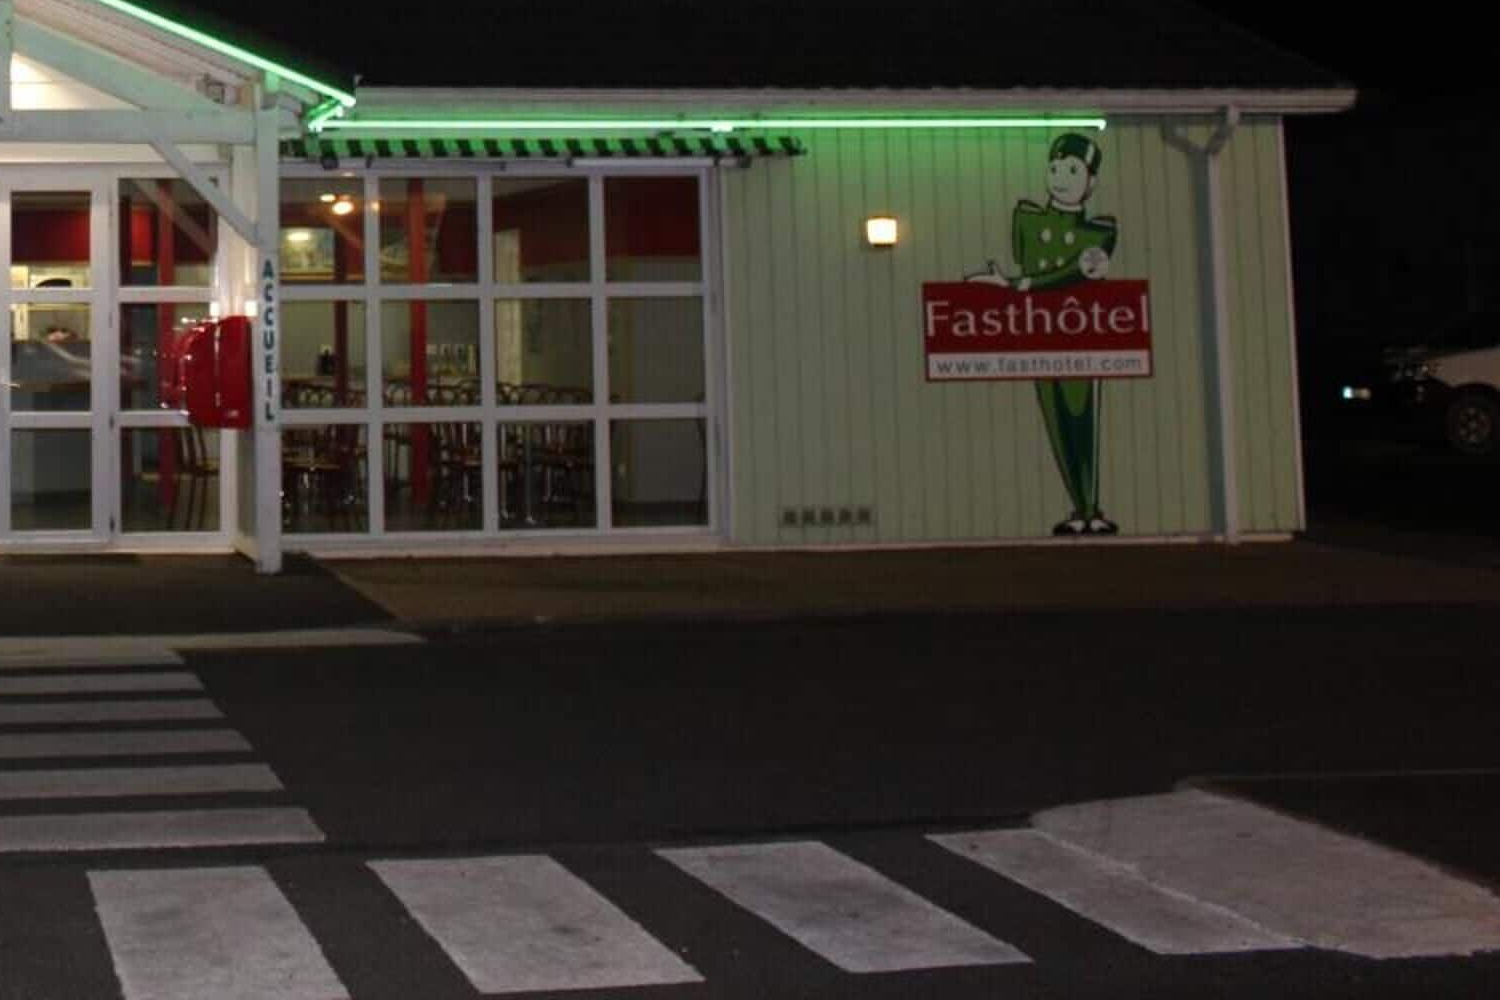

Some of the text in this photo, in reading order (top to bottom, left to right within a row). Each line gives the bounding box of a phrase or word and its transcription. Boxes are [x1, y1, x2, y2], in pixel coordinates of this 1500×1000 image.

[926, 294, 1149, 337] Fasthôtel
[261, 259, 274, 422] ACCUEIL
[934, 355, 1142, 374] www.fasthotel.com
